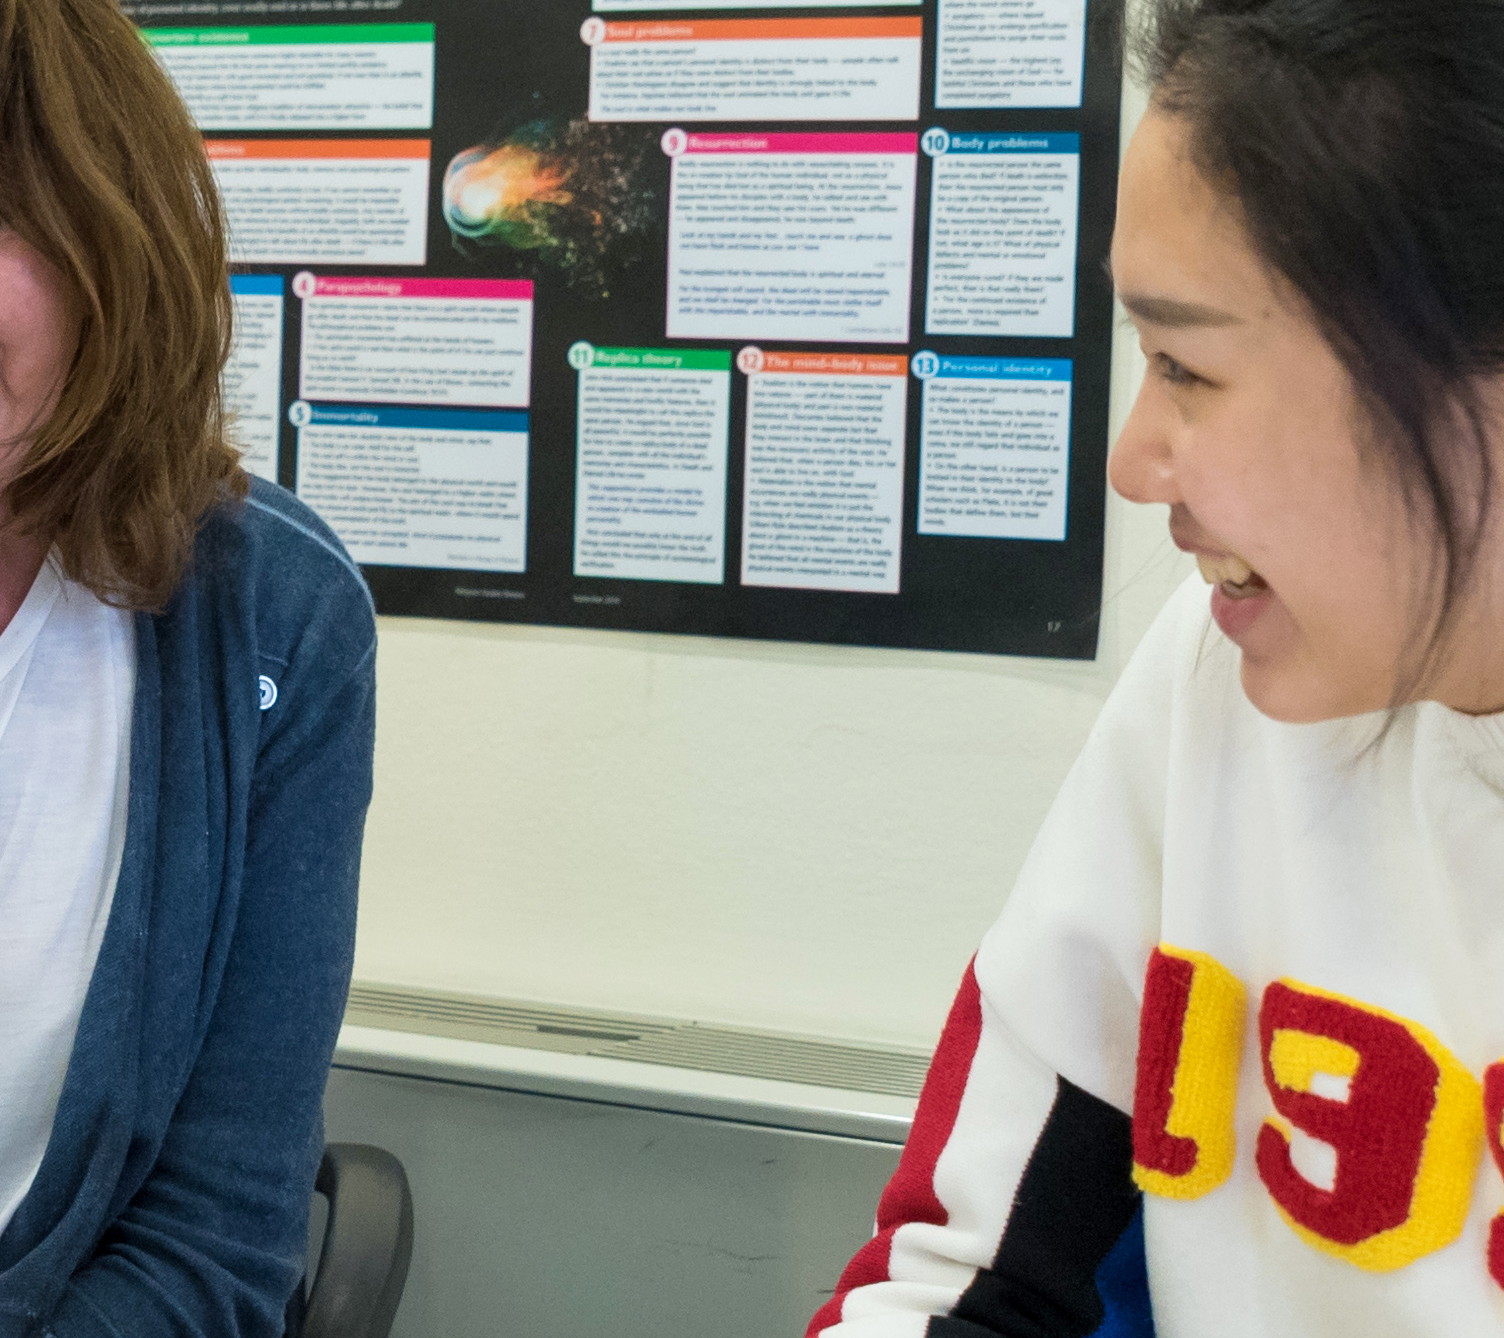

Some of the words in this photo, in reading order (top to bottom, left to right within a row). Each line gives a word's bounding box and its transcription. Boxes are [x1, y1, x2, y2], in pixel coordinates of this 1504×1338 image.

[689, 135, 768, 151] Resurrection
[926, 133, 945, 152] 10
[952, 136, 985, 152] Body
[988, 136, 1049, 152] problems
[317, 281, 402, 295] Parapsychology
[574, 350, 588, 363] 11
[595, 351, 639, 365] Replica
[642, 352, 682, 368] theory
[743, 354, 758, 367] 12
[766, 356, 789, 368] The
[917, 358, 934, 373] 13
[942, 362, 997, 373] Personal
[1003, 363, 1052, 376] identity
